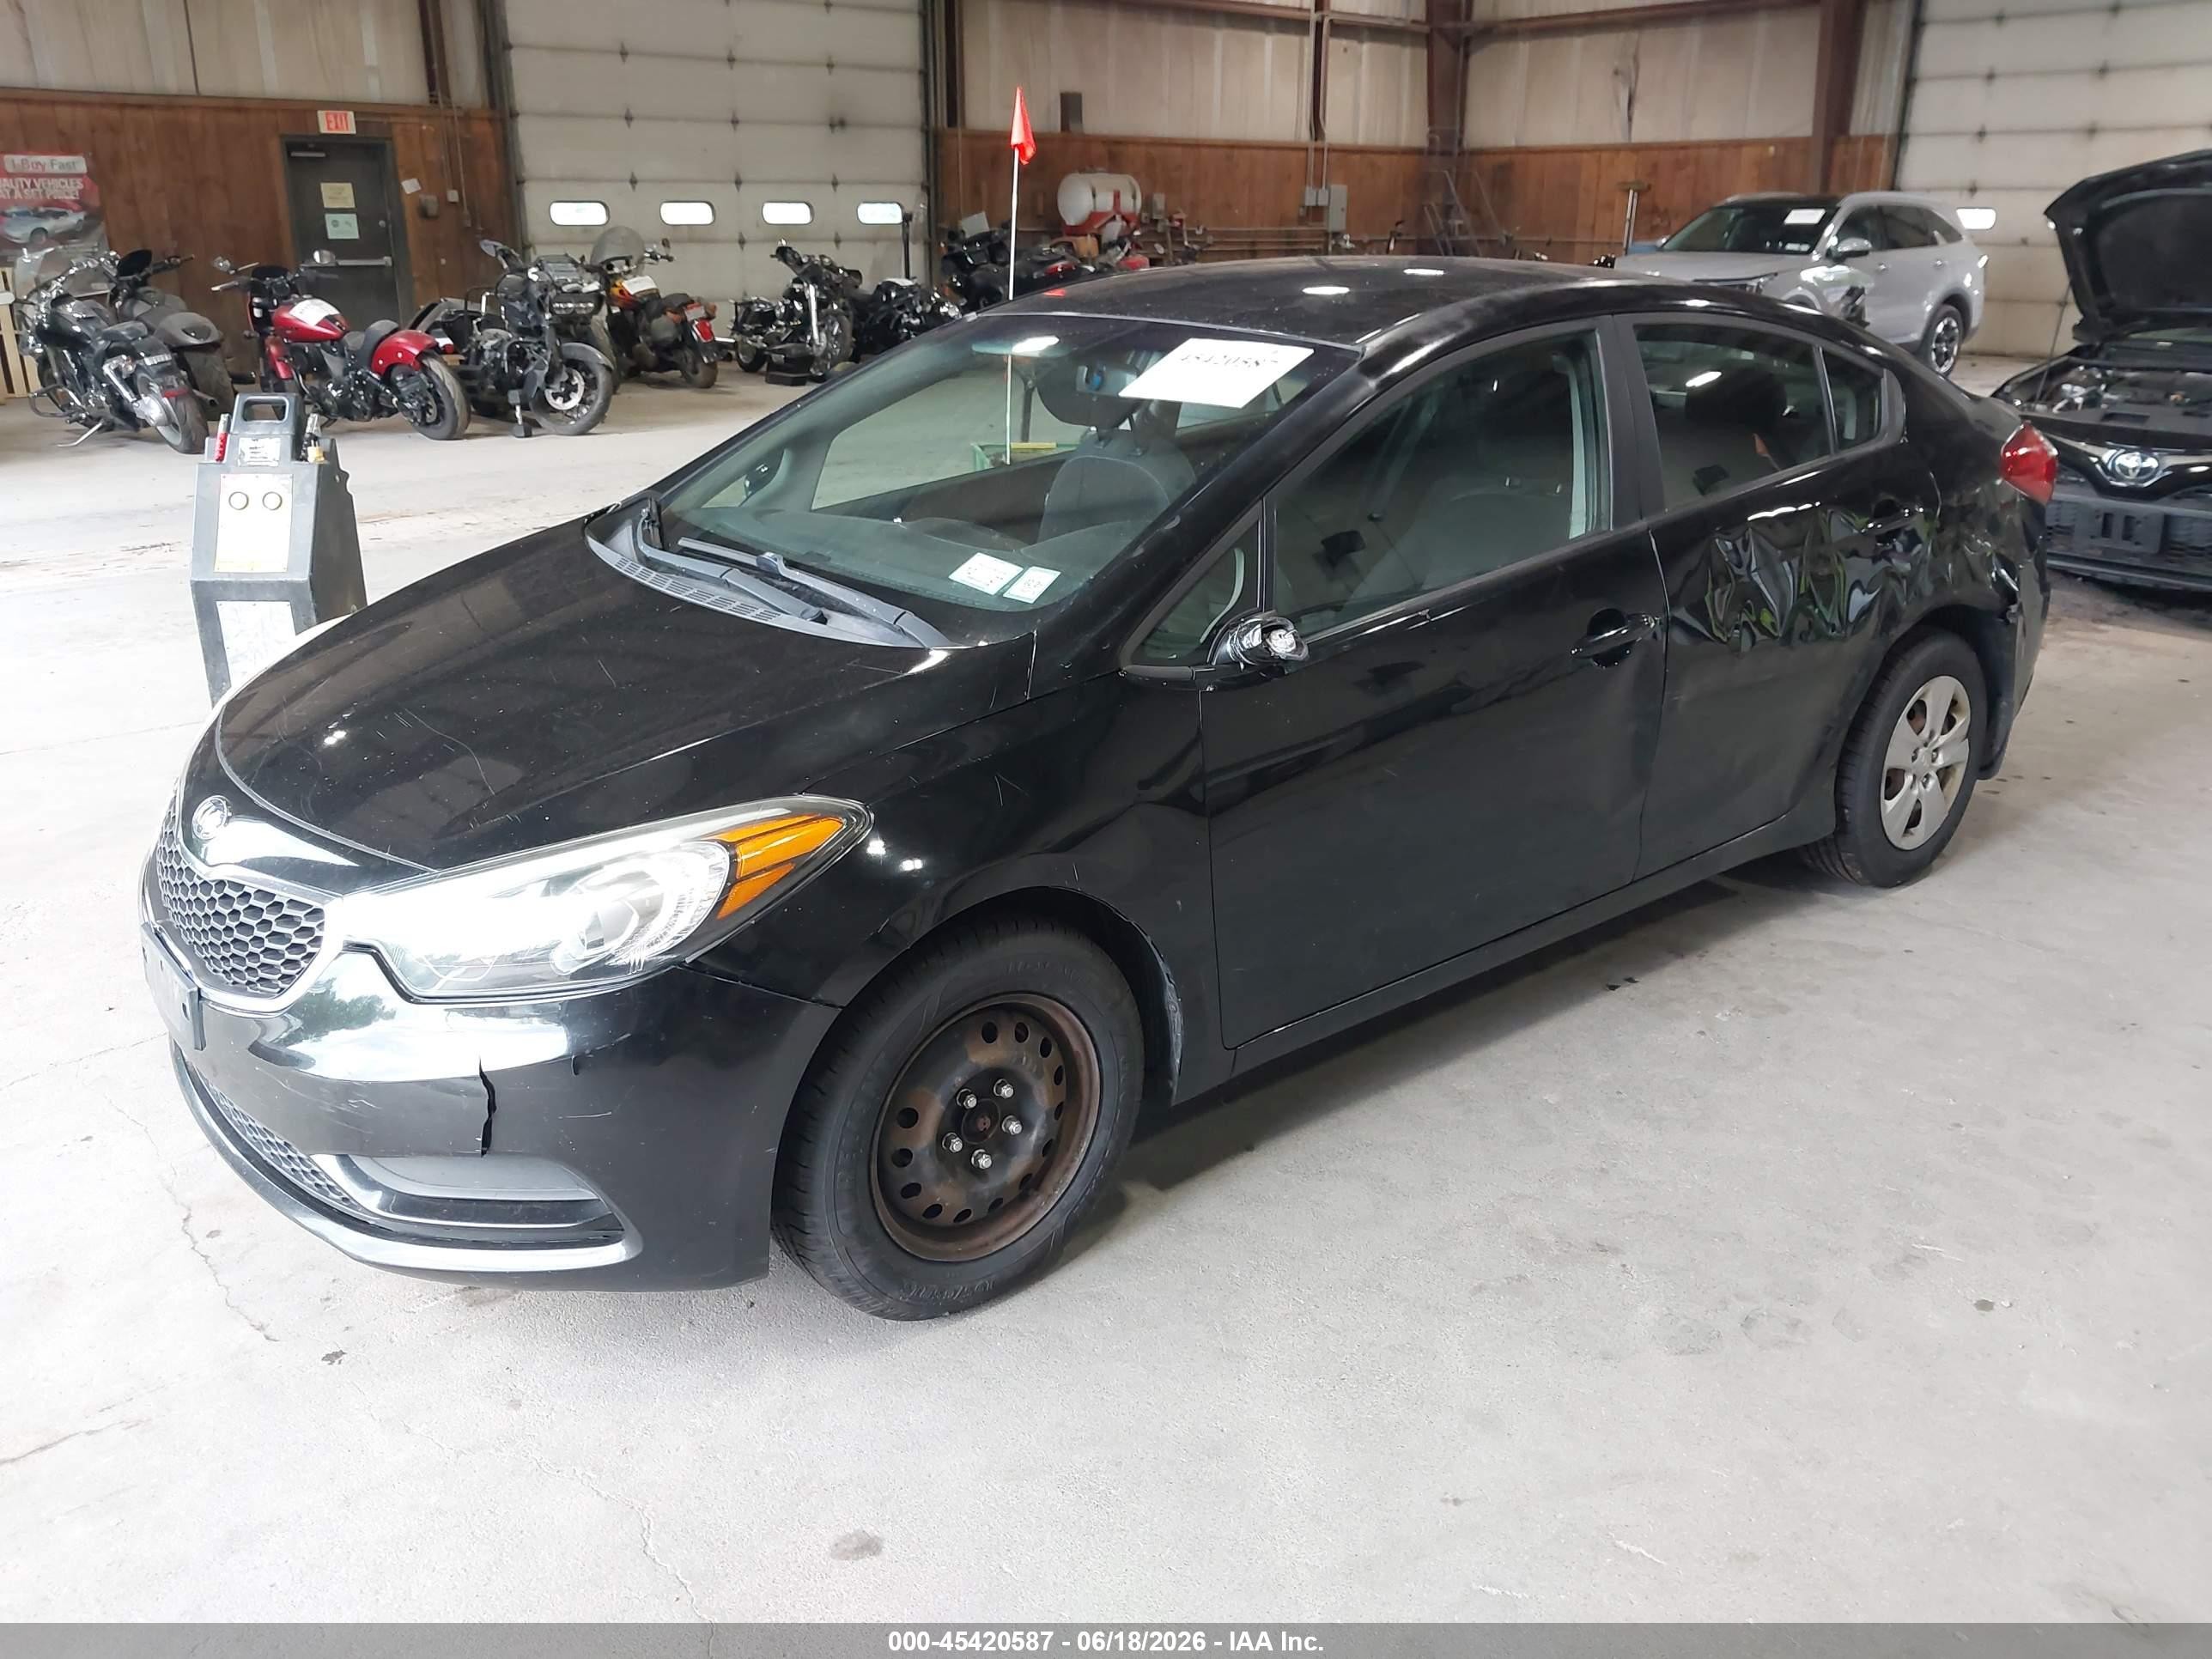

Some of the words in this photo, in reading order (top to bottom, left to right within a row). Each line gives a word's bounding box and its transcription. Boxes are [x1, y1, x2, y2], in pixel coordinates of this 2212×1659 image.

[325, 111, 349, 131] EXIT
[50, 158, 76, 170] Fast
[32, 177, 83, 190] VEHICLES
